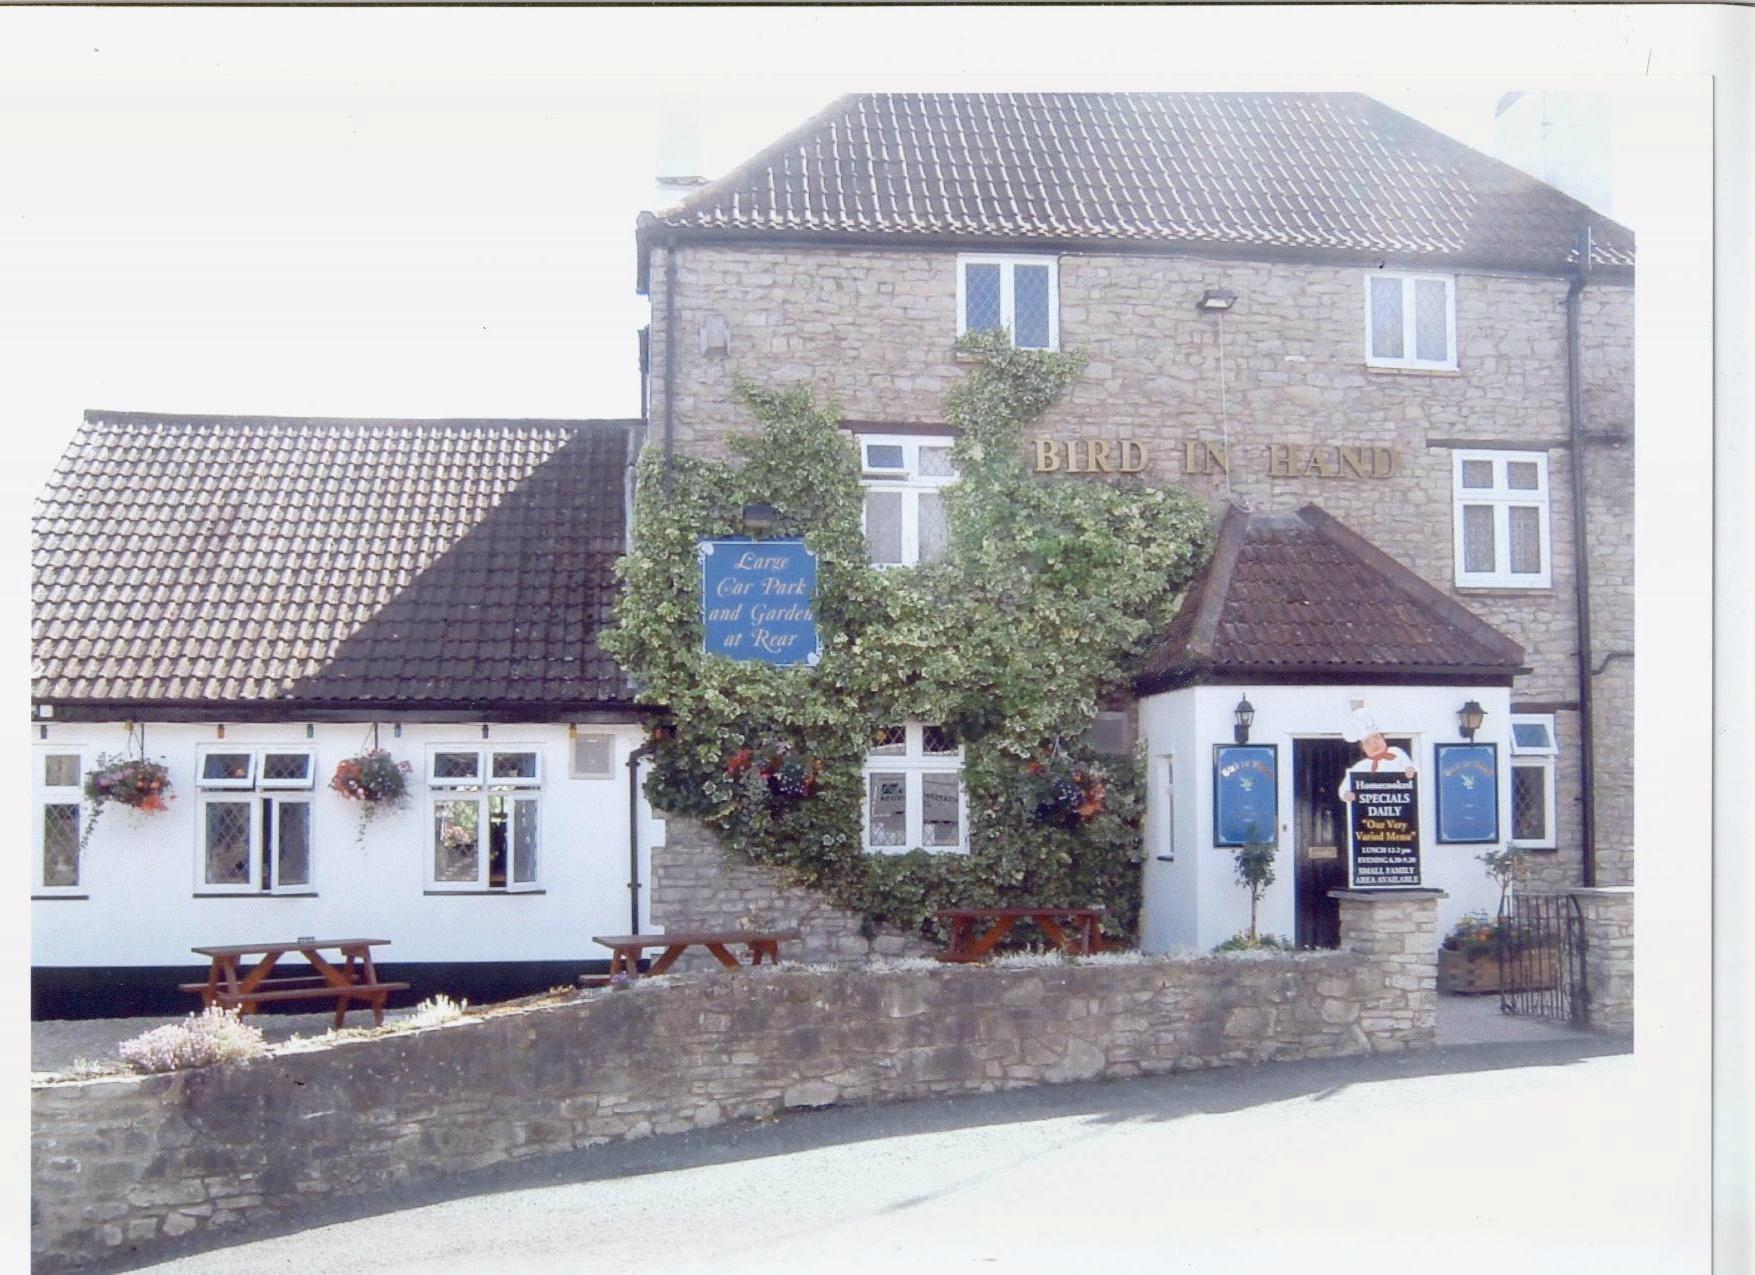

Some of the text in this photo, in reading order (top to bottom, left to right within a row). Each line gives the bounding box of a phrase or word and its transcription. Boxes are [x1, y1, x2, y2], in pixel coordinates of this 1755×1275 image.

[1033, 439, 1400, 478] BIRD IN HAND
[736, 553, 789, 571] Large
[716, 577, 807, 598] Car Park
[709, 603, 813, 625] and Garden
[724, 628, 798, 653] at Rear
[1359, 793, 1410, 804] SPECIALS
[1367, 806, 1402, 817] DAILY
[1386, 819, 1408, 831] Very
[1386, 866, 1415, 874] FAMILY
